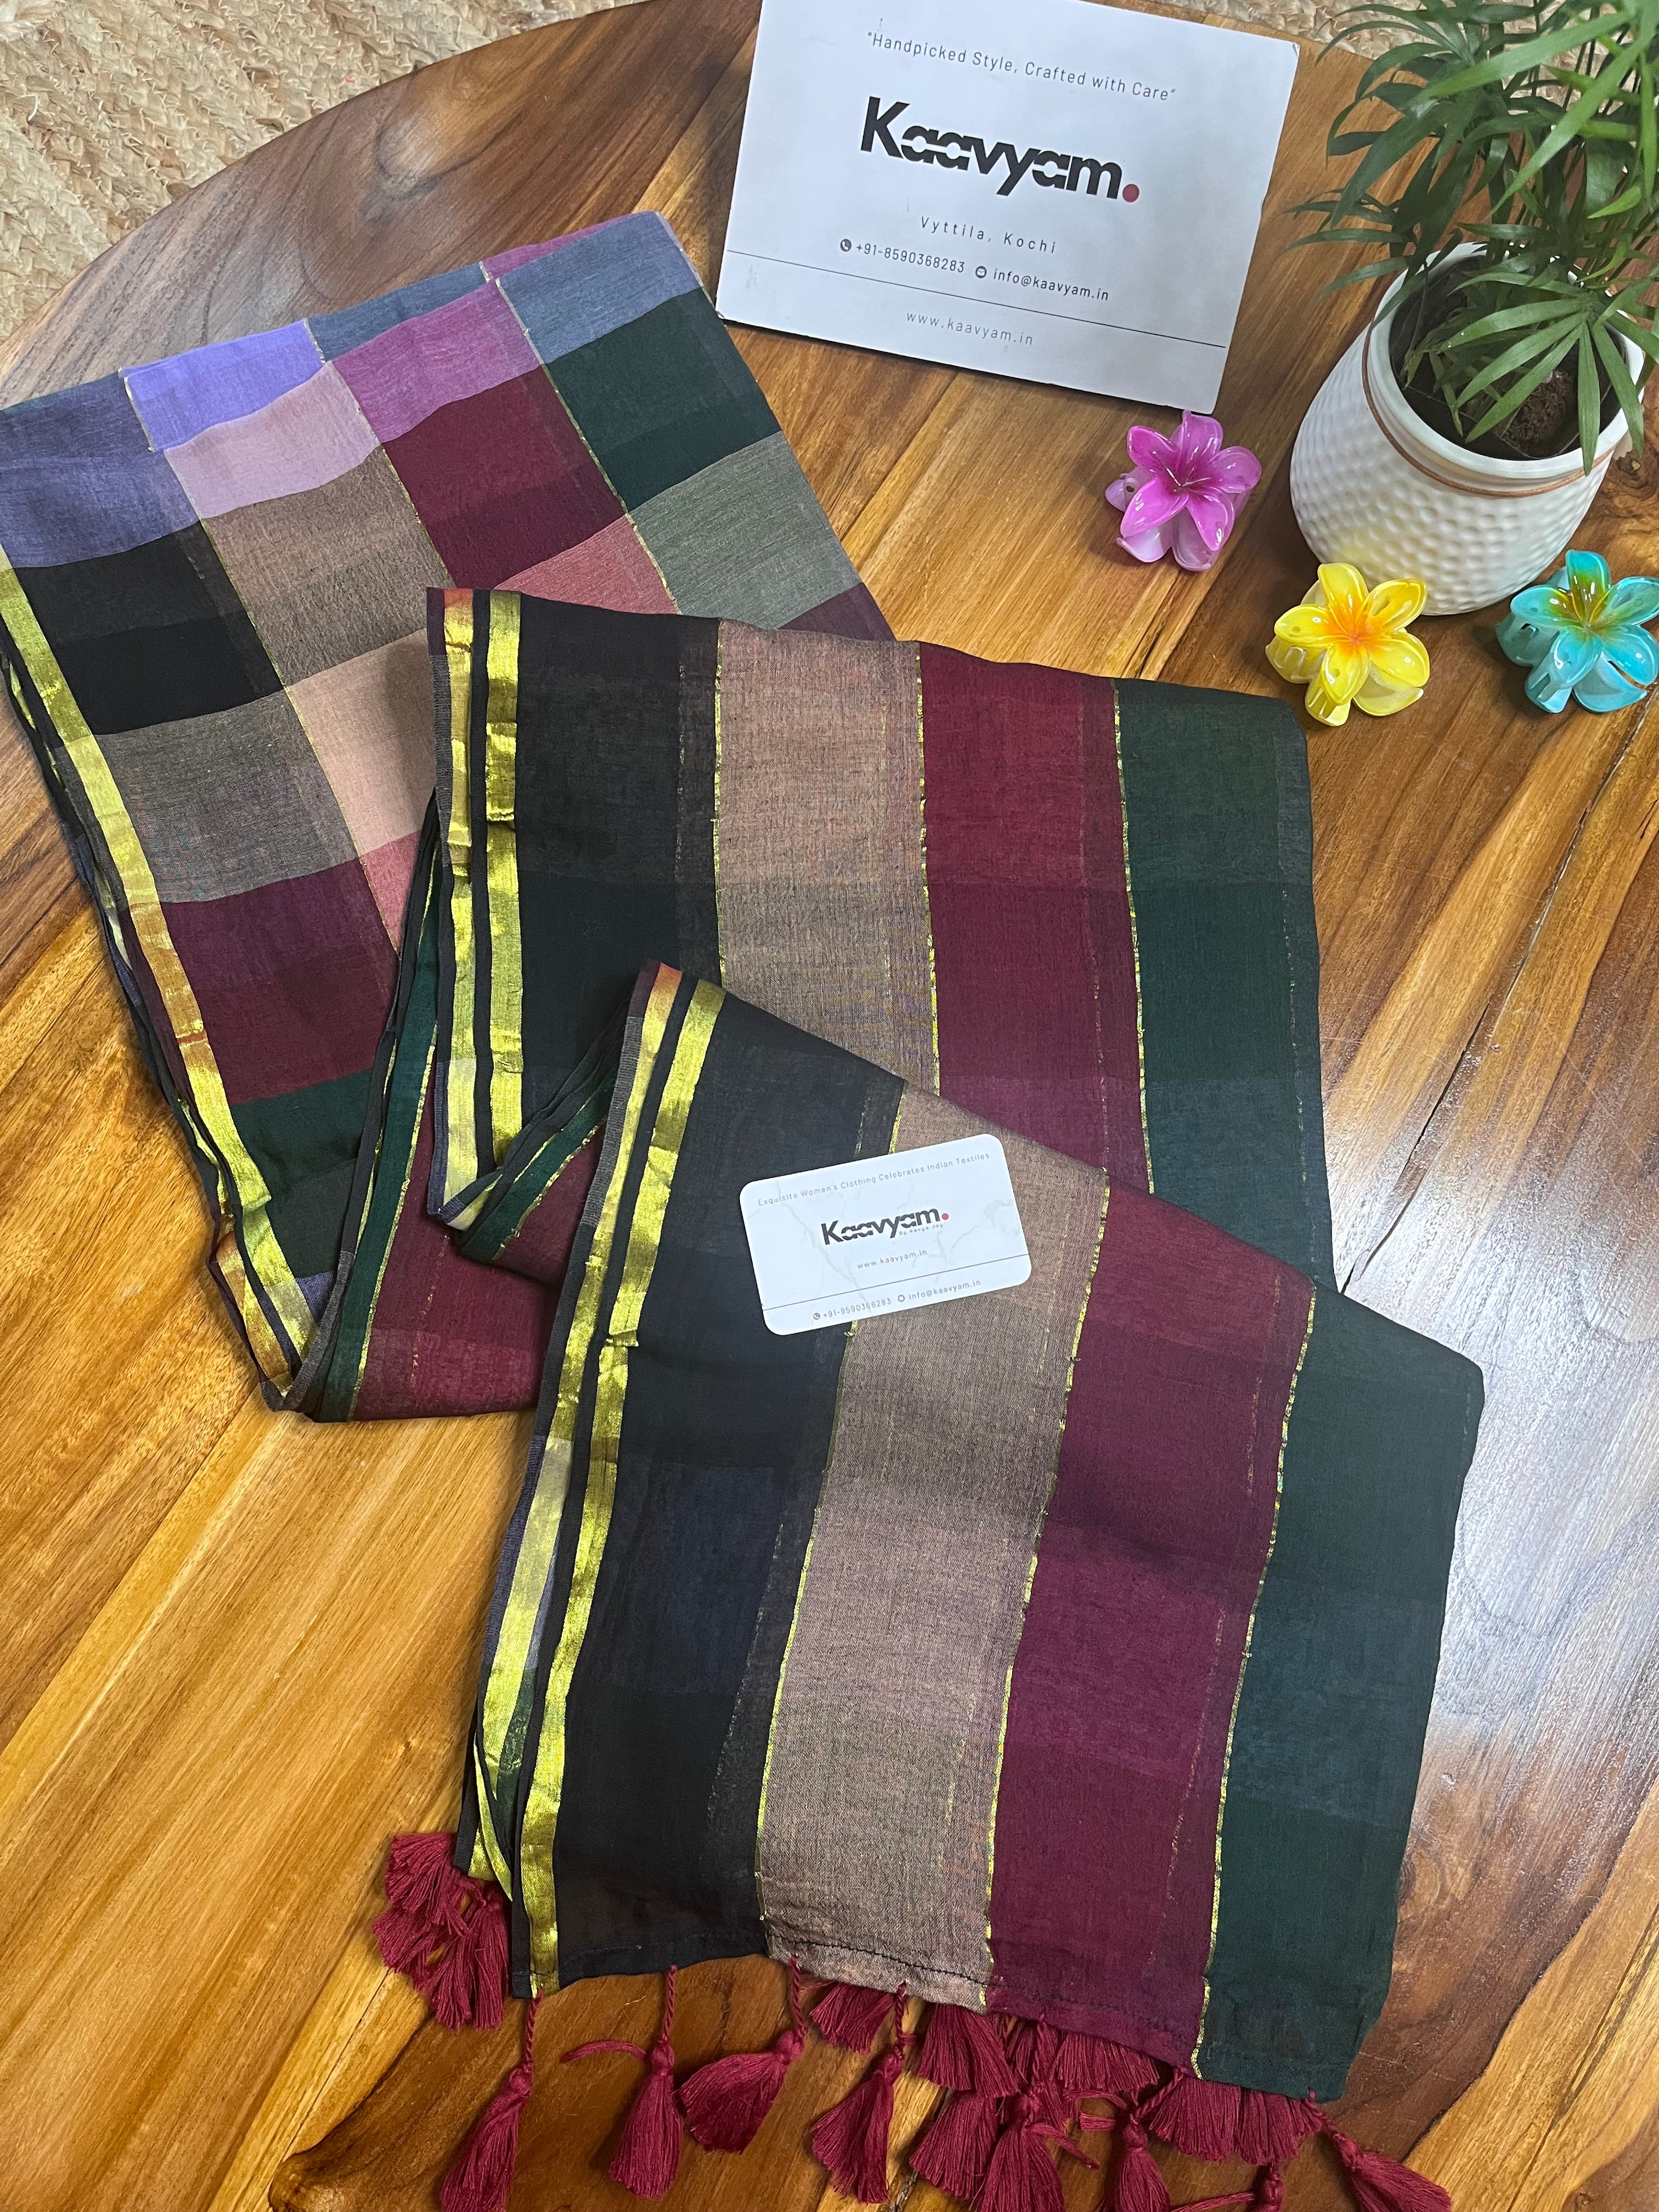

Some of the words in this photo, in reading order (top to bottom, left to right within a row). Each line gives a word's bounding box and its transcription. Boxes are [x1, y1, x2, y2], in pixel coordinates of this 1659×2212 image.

[973, 52, 1017, 74] Style,
[1025, 61, 1086, 85] Crafted
[1092, 76, 1126, 92] with
[860, 96, 1139, 202] Kaavyam.
[921, 216, 991, 242] Vyttila,
[1003, 232, 1056, 253] Kochi
[856, 243, 965, 273] +91-8590368283
[994, 268, 1109, 301] info@kaavyam.in
[906, 313, 1033, 346] www.kaavyam.in
[758, 1193, 798, 1206] Exquisite
[800, 1183, 838, 1197] Women's
[840, 1176, 876, 1189] Clothing
[878, 1166, 925, 1181] Celebrates
[927, 1160, 953, 1171] Indian
[956, 1153, 990, 1165] Textiles
[821, 1208, 949, 1245] Kaavyam.
[857, 1249, 927, 1269] www.kaavyam.in
[823, 1297, 892, 1318] +91-8590368283
[909, 1279, 981, 1300] info@kaavyam.in
